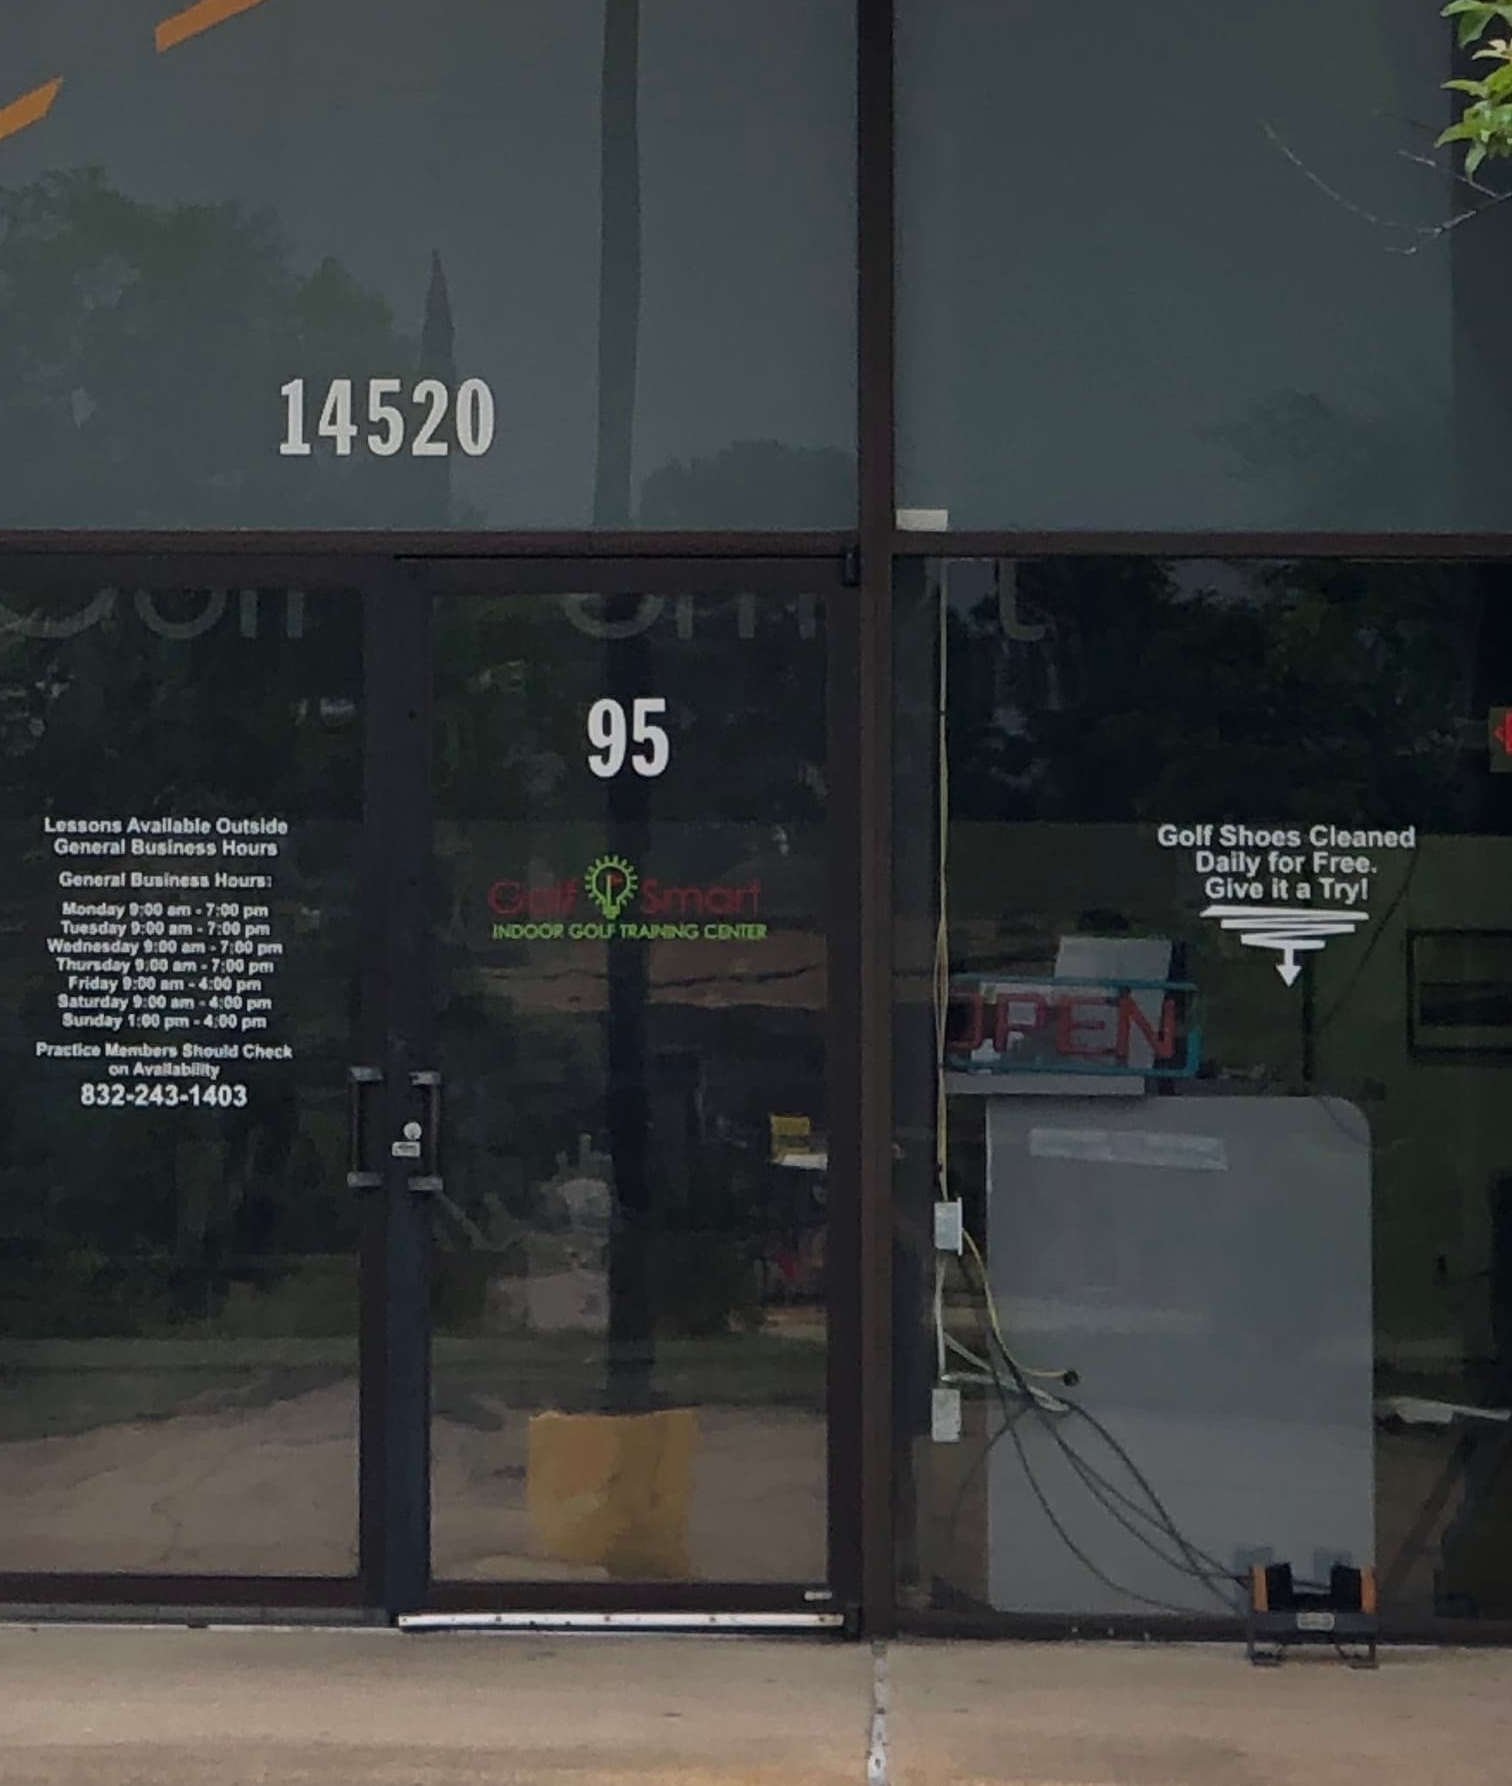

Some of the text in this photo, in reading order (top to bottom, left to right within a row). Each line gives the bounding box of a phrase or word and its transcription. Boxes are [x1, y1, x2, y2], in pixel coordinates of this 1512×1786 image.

[279, 378, 494, 456] 14520
[587, 697, 670, 778] 95
[44, 816, 288, 835] Lessons Available Outside
[1157, 824, 1415, 848] Golf Shoes Cleaned
[53, 837, 278, 856] General Business Hours
[1195, 850, 1377, 876] Daily for Free.
[58, 871, 272, 888] General Business Hours:
[641, 876, 760, 914] Smart
[1205, 877, 1368, 905] Give it a Try!
[62, 901, 126, 920] Monday
[129, 902, 163, 917] 9:00
[167, 905, 192, 917] am
[205, 902, 240, 918] 7:00
[243, 906, 269, 920] pm
[60, 919, 127, 938] Tuesday
[130, 920, 165, 936] 9:00
[168, 924, 193, 936] am
[207, 920, 241, 936] 7:00
[244, 924, 270, 939] pm
[492, 923, 769, 941] INDOOR GOLF TRAINING CENTER
[46, 938, 140, 957] Wednesday
[143, 938, 178, 954] 9:00
[181, 942, 206, 954] am
[220, 939, 254, 955] 7:00
[257, 943, 283, 957] pm
[55, 956, 131, 975] Thursday
[134, 958, 169, 973] 9:00
[172, 960, 197, 972] am
[211, 957, 245, 973] 7:00
[248, 961, 274, 976] pm
[68, 975, 119, 994] Friday
[122, 975, 157, 991] 9:00
[160, 979, 185, 991] am
[198, 976, 233, 991] 4:00
[236, 979, 262, 994] pm
[58, 993, 129, 1012] Saturday
[132, 994, 167, 1009] 9:00
[170, 997, 195, 1009] am
[208, 995, 243, 1010] 4:00
[246, 998, 272, 1012] pm
[62, 1012, 123, 1031] Sunday
[127, 1013, 160, 1028] 1:00
[164, 1016, 190, 1031] pm
[203, 1013, 238, 1029] 4:00
[241, 1017, 267, 1032] pm
[36, 1041, 293, 1060] Practice Members Should Check
[108, 1061, 220, 1080] on Availability
[80, 1083, 248, 1107] 832-243-1403
